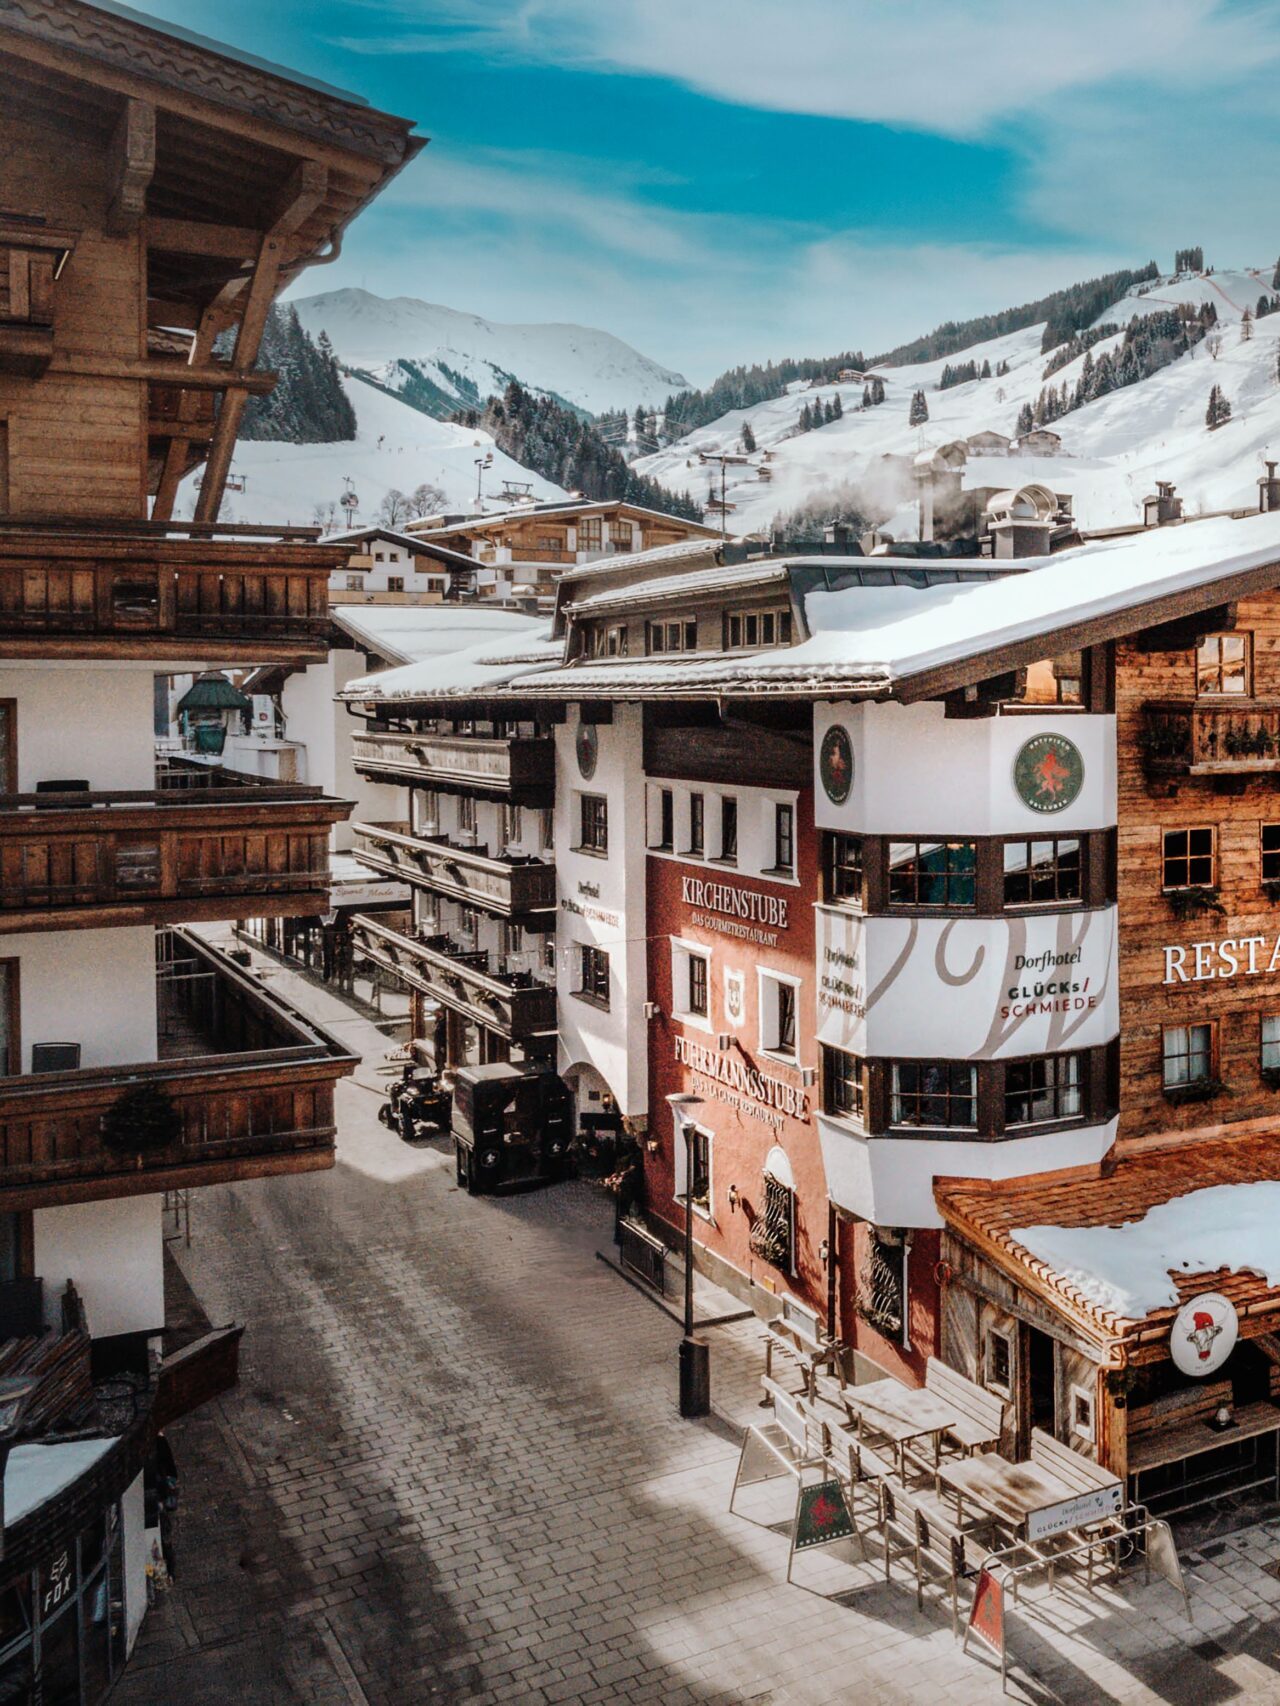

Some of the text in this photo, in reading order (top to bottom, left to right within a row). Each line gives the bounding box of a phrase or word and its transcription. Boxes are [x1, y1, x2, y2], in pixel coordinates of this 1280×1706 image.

[681, 876, 789, 929] KIRCHENSTUBE
[1014, 946, 1082, 972] Dorfhotel
[1000, 996, 1097, 1019] SCHMIEDE
[674, 1034, 808, 1122] FUHRMANNSSTUBE
[44, 1573, 72, 1612] FOX
